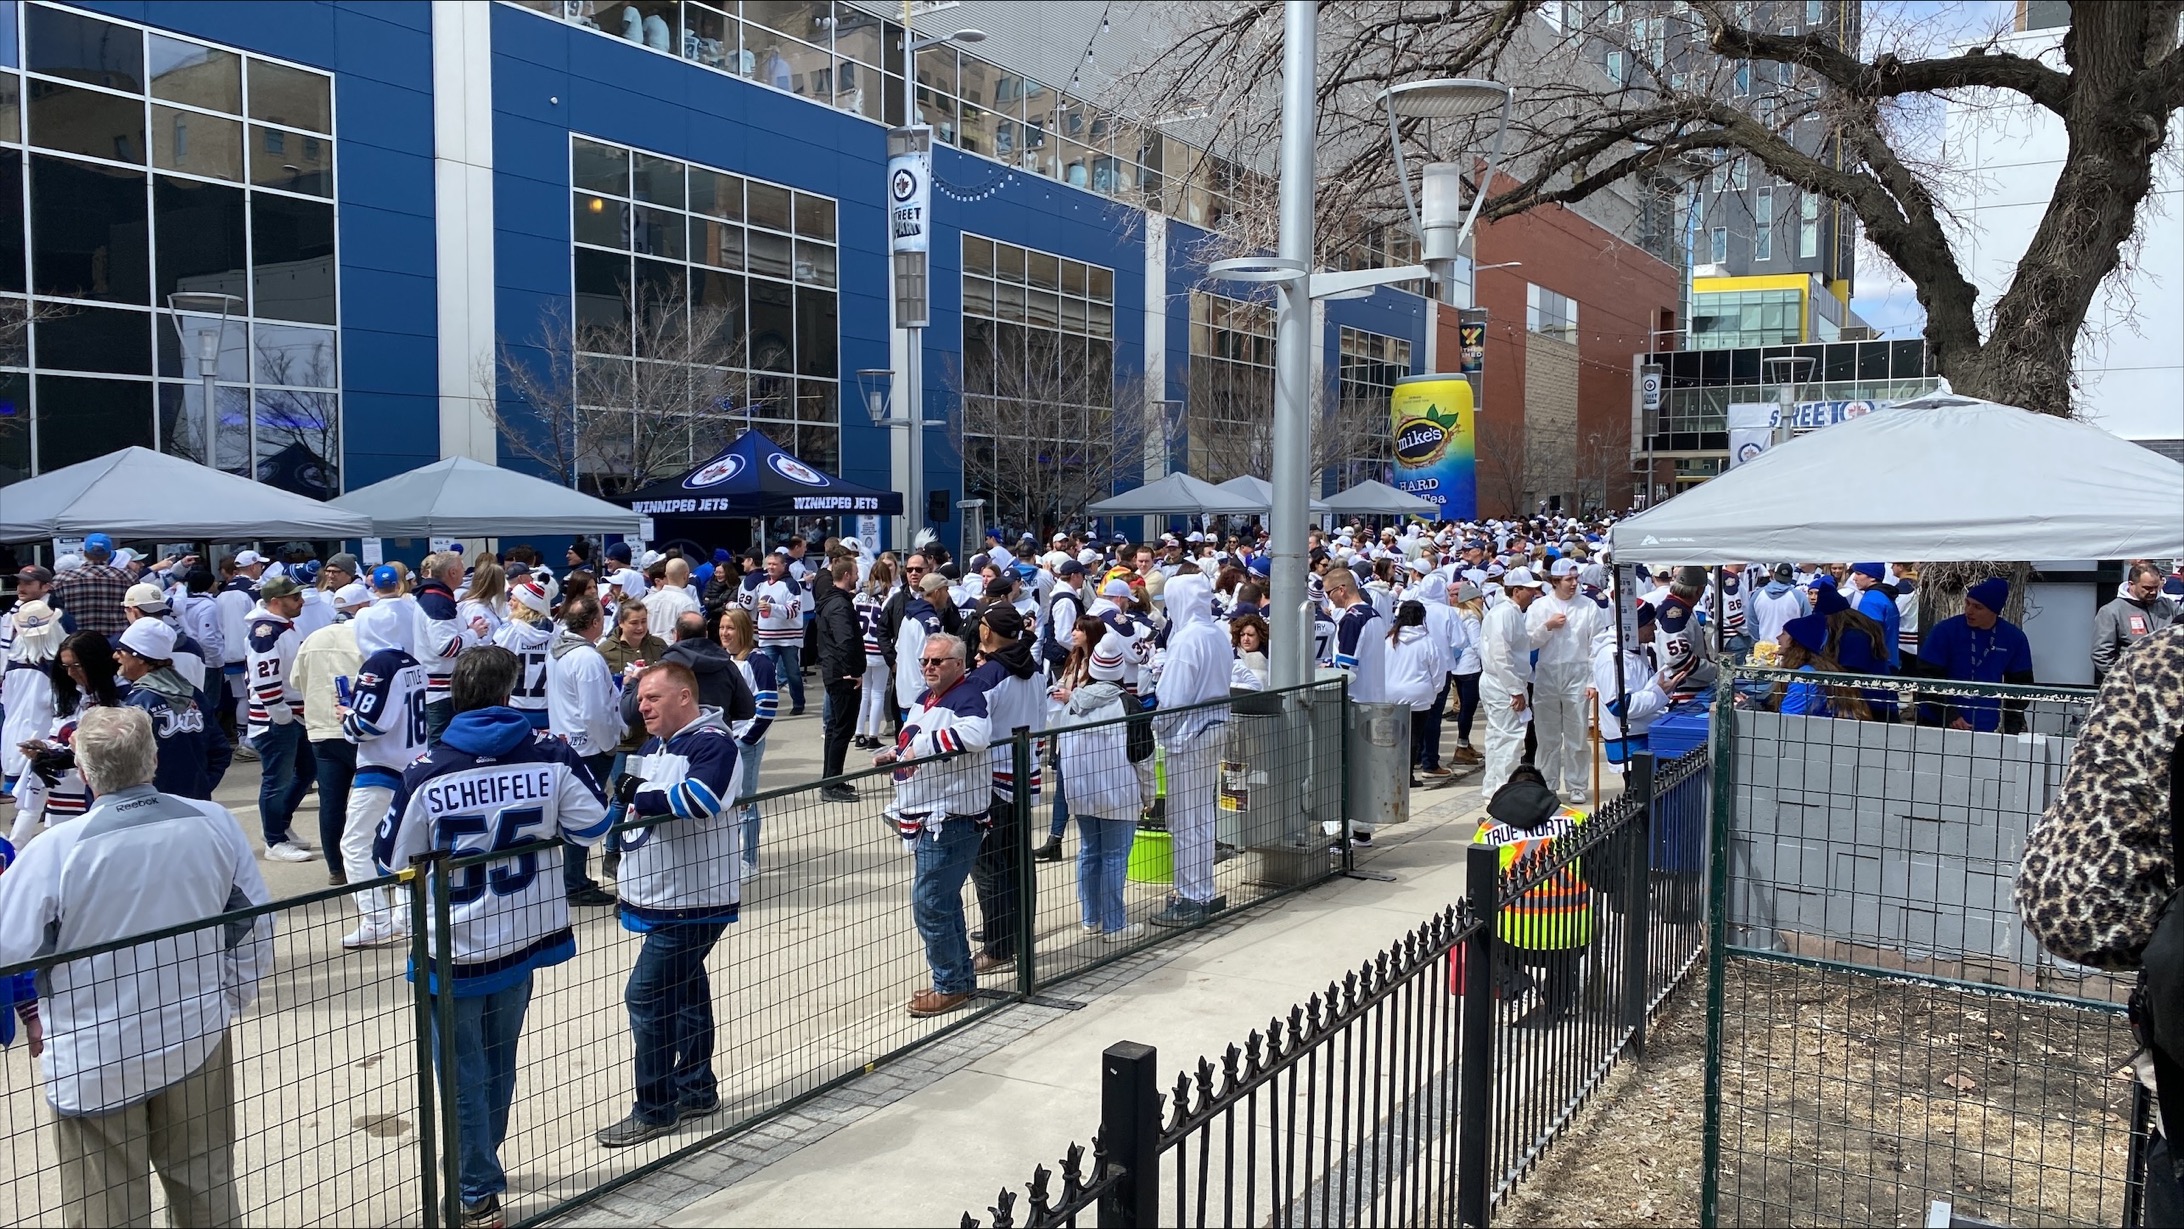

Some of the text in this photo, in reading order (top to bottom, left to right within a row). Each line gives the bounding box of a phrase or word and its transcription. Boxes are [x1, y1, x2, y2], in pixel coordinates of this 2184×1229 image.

[1398, 427, 1443, 452] mike's
[1399, 478, 1439, 492] HARD
[632, 498, 729, 514] WINNIPEG JETS
[793, 496, 879, 510] WINNIPEG JETS
[739, 593, 753, 605] 29
[1728, 599, 1742, 611] 26
[1666, 639, 1691, 656] 55
[257, 658, 280, 678] 27
[511, 653, 547, 697] 17
[404, 669, 422, 688] LITTLE
[352, 690, 377, 713] 18
[404, 688, 427, 749] 18
[428, 772, 549, 813] SCHEIFELE
[116, 797, 159, 813] Reebok
[1485, 818, 1576, 846] TRUE NORTH
[434, 806, 544, 905] 55
